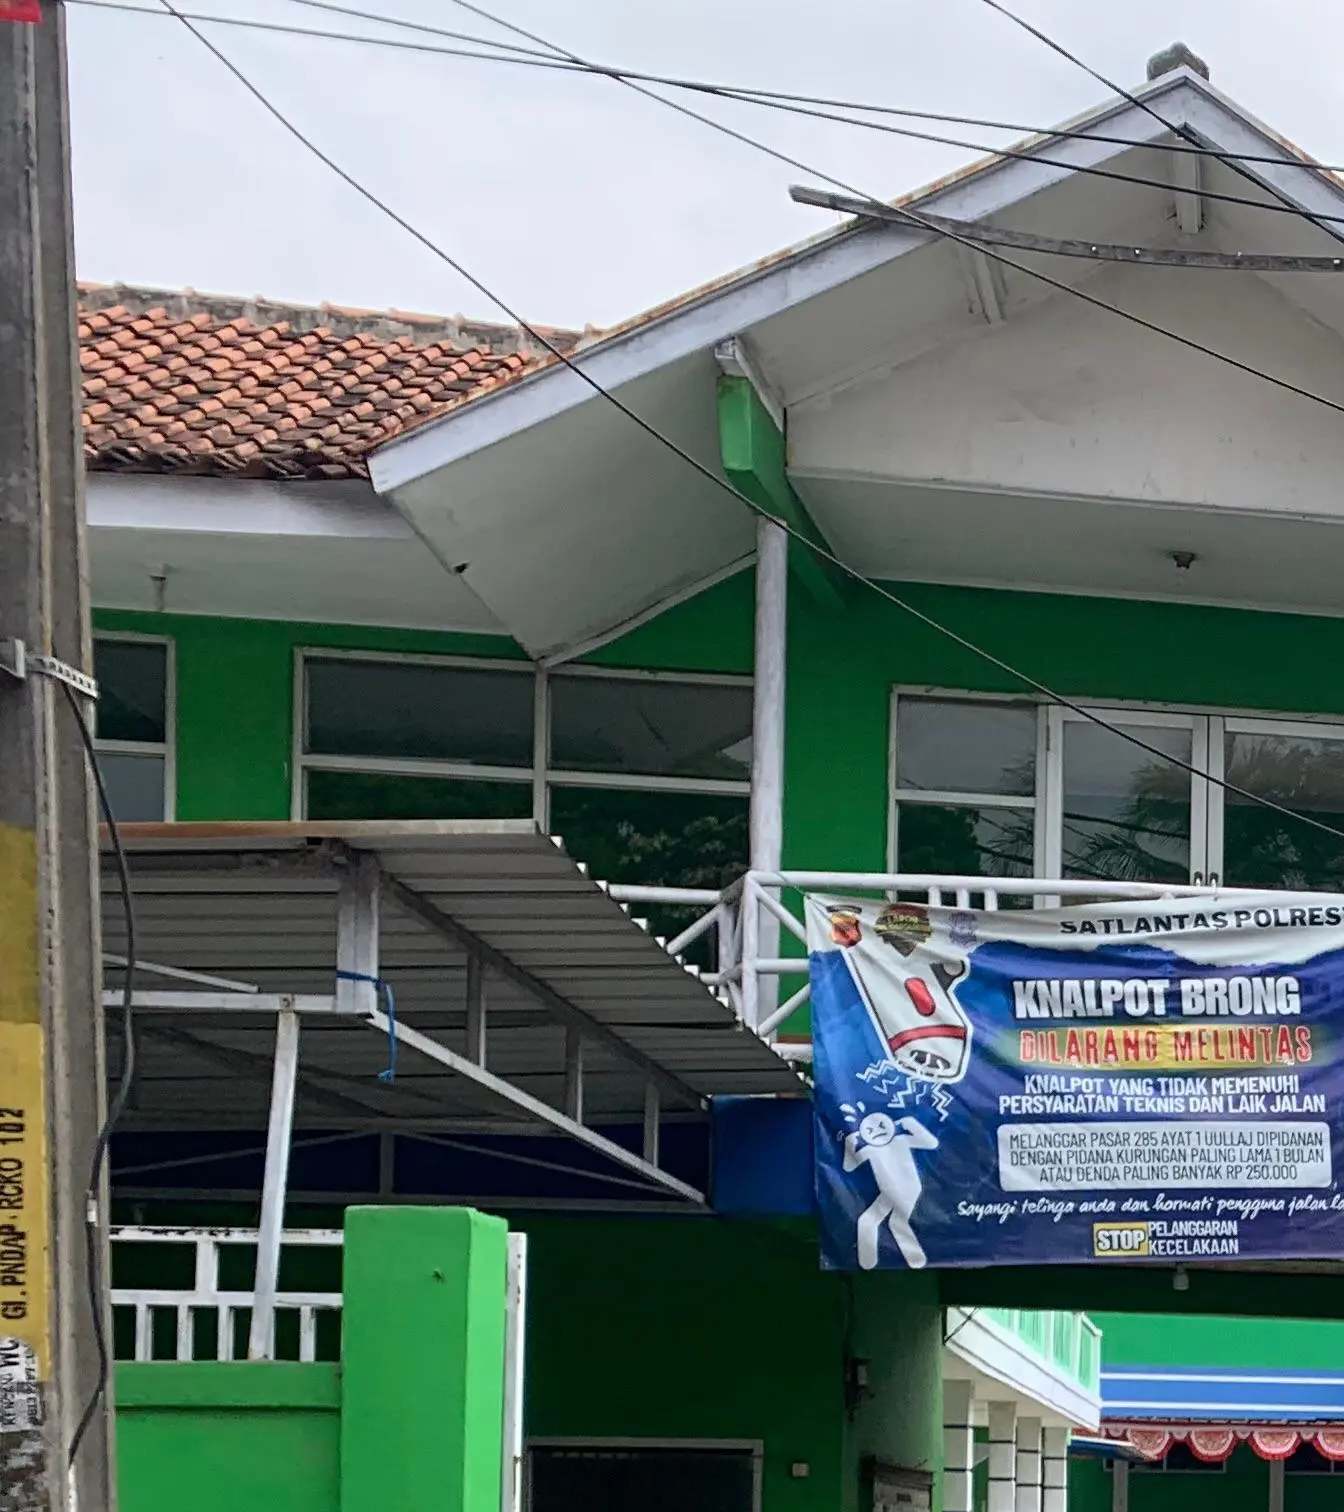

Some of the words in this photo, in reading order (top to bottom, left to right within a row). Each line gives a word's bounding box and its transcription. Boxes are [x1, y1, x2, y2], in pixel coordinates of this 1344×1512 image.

[1060, 911, 1227, 935] SATLANTAS
[1013, 978, 1169, 1019] KNALPOT
[1180, 976, 1301, 1016] BRONG
[1019, 1027, 1159, 1065] DILARANG
[1172, 1025, 1312, 1063] MELINTAS
[1024, 1076, 1104, 1094] KNALPOT
[1107, 1078, 1153, 1095] YANG
[1157, 1077, 1209, 1094] TIDAK
[1212, 1075, 1299, 1094] MEMENUHI
[1000, 1094, 1118, 1114] PERSYARATAN
[1122, 1095, 1185, 1113] TEKNIS
[1189, 1095, 1226, 1113] DAN
[1228, 1096, 1267, 1113] LAIK
[1271, 1095, 1325, 1113] JALAN
[1010, 1132, 1087, 1149] MELANGGAR
[1090, 1132, 1131, 1148] PASAR
[1134, 1132, 1158, 1147] 285
[1161, 1132, 1192, 1147] AYAT
[1257, 1131, 1323, 1147] DIPIDANAN
[1011, 1151, 1064, 1167] DENGAN
[1067, 1150, 1114, 1165] PIDANA
[1116, 1150, 1187, 1165] KURUNGAN
[1191, 1149, 1236, 1164] PALING
[1239, 1149, 1273, 1163] LAMA
[1284, 1149, 1324, 1163] BULAN
[1040, 1167, 1073, 1182] ATAU
[1076, 1166, 1120, 1182] DENDA
[1123, 1166, 1169, 1181] PALING
[1173, 1165, 1223, 1180] BANYAK
[1226, 1165, 1243, 1180] RP
[1245, 1165, 1298, 1180] 250.000
[957, 1199, 1018, 1224] Sayangi
[1021, 1198, 1074, 1223] telinga
[1079, 1199, 1116, 1213] anda
[1120, 1198, 1149, 1212] dan
[1152, 1194, 1213, 1212] hormati
[1216, 1199, 1285, 1219] pengguna
[1287, 1196, 1328, 1216] jalan
[1148, 1221, 1238, 1237] PELANGGARAN
[1097, 1229, 1147, 1252] STOP
[1149, 1239, 1239, 1255] KECELAKAAN
